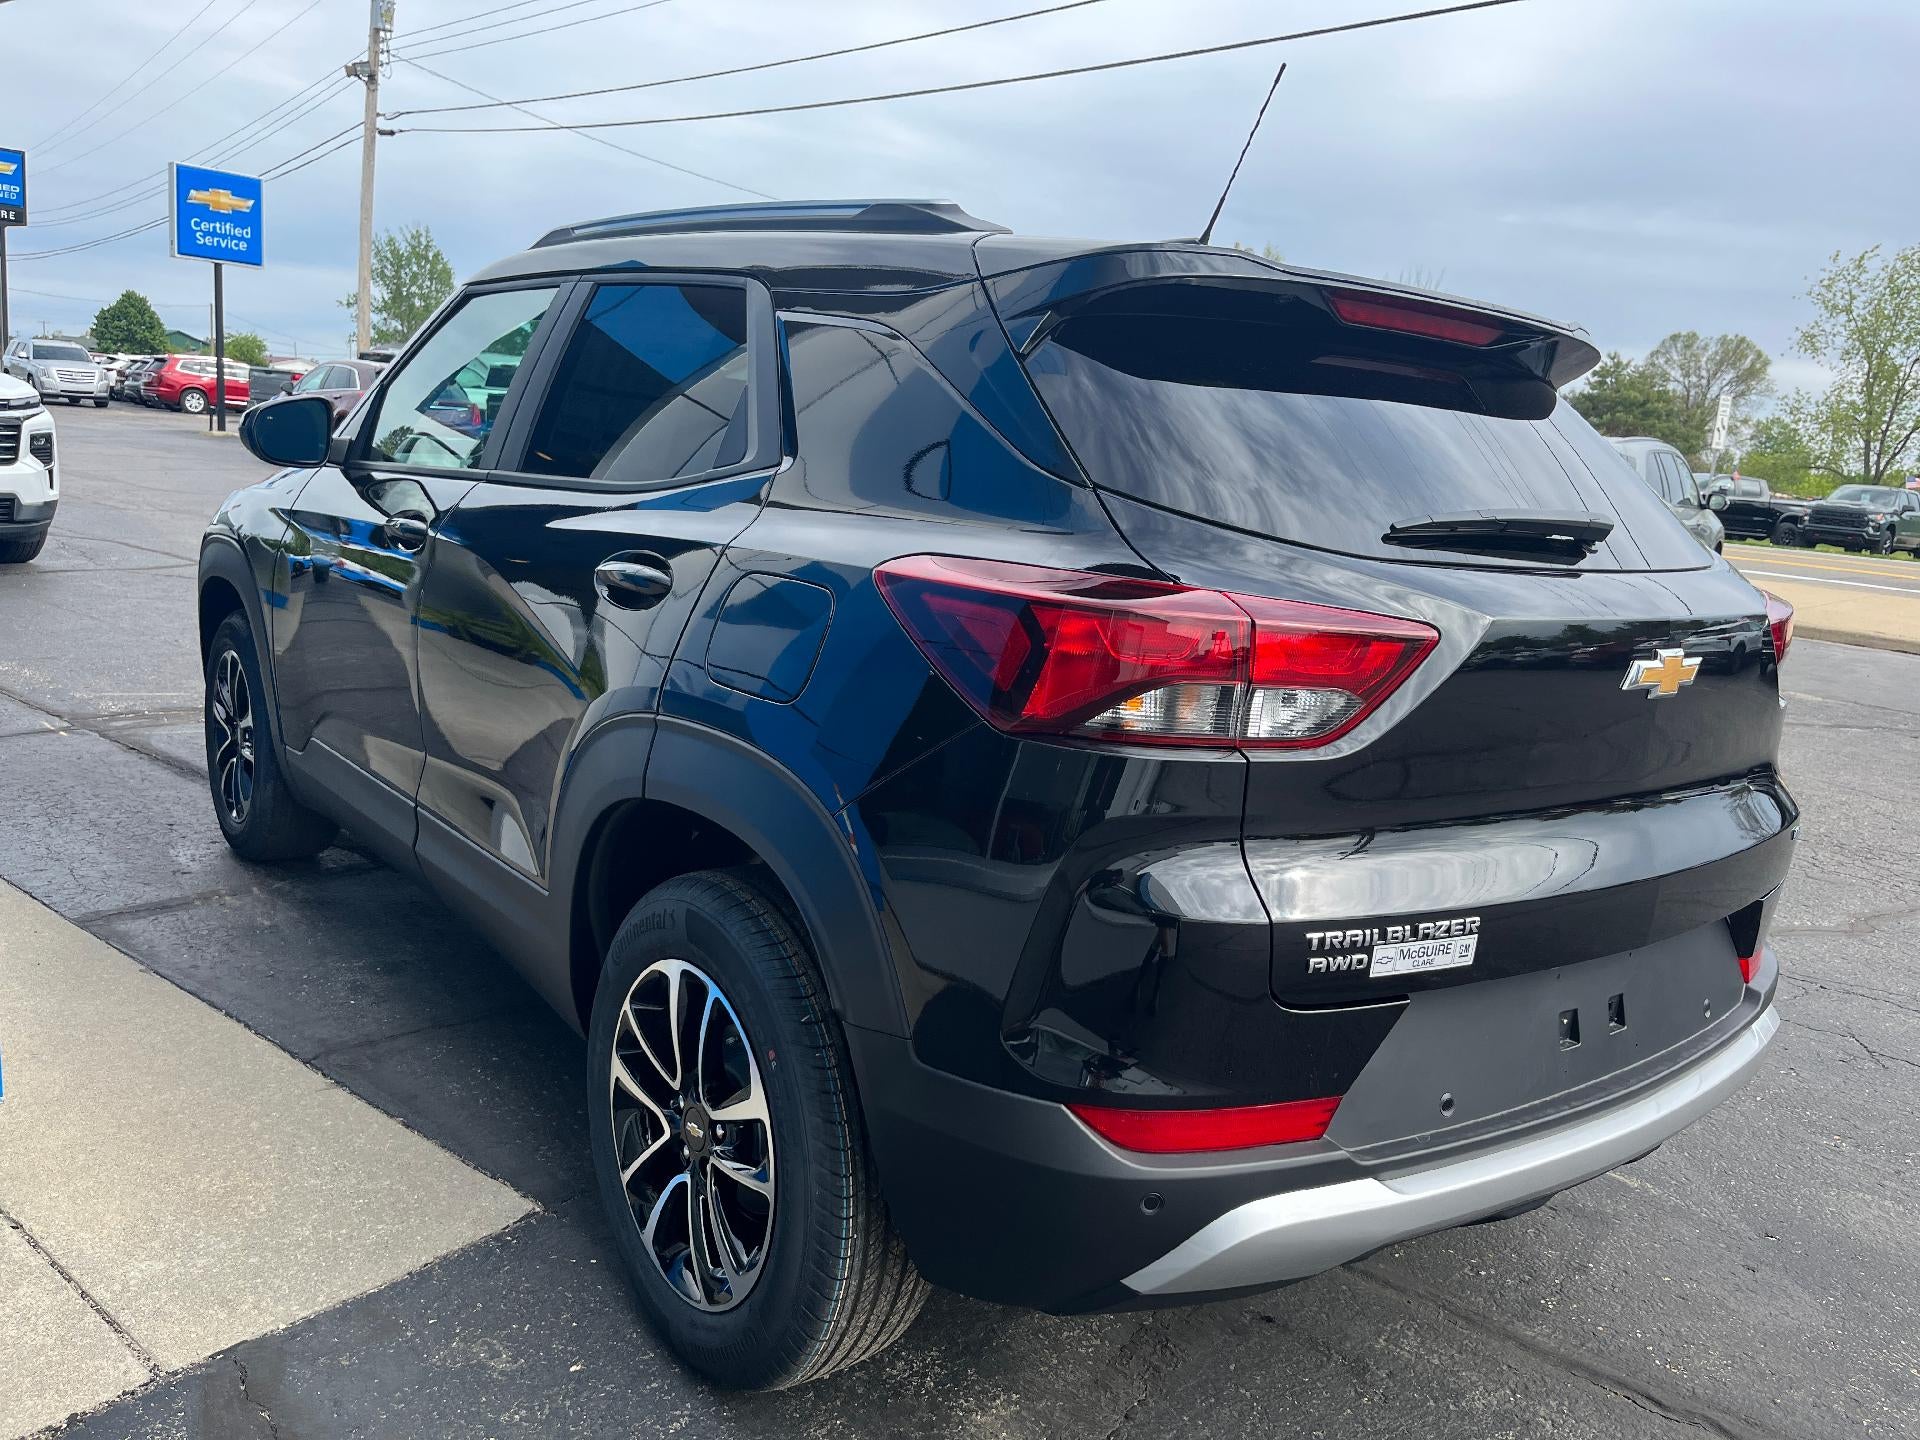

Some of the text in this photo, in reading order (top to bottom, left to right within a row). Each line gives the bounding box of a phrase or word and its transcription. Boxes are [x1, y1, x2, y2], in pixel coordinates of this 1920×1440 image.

[190, 217, 251, 239] Certified
[195, 231, 248, 251] Service
[1305, 916, 1481, 951] TRAILBLAZER
[1399, 942, 1453, 961] McGUIRE
[1308, 953, 1369, 974] AWD
[1412, 958, 1435, 968] CLARE
